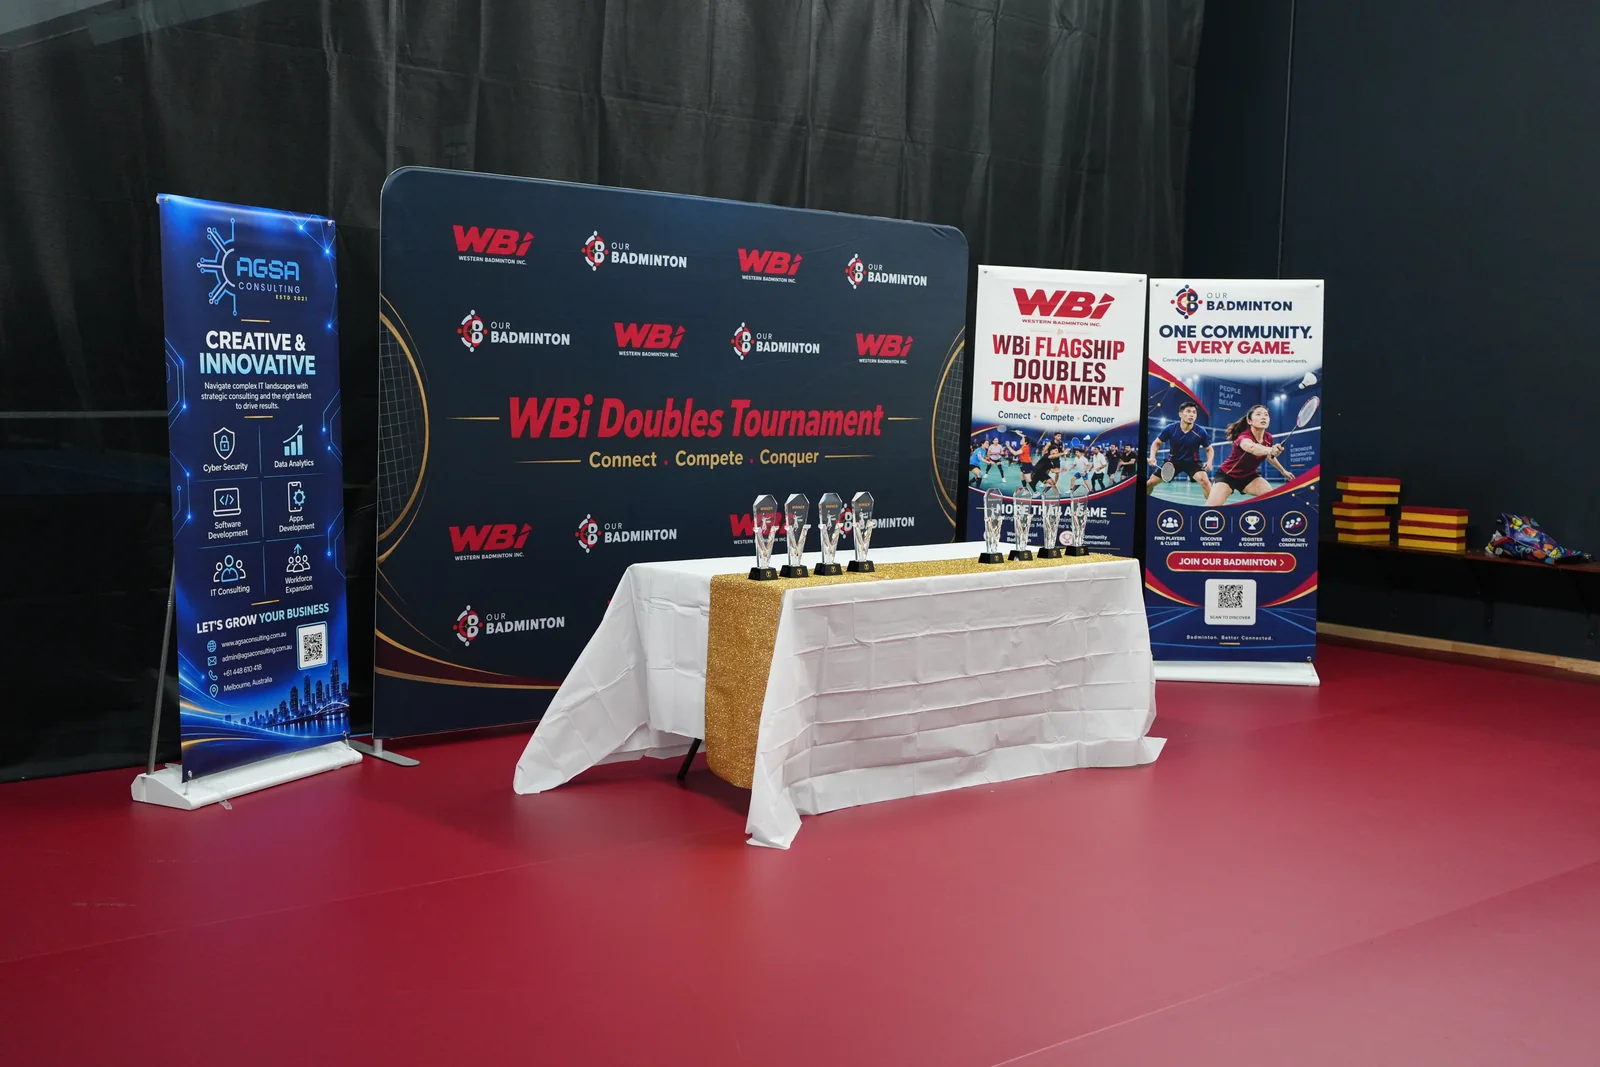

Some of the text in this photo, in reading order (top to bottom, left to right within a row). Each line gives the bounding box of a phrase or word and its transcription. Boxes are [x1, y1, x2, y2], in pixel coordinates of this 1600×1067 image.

[611, 242, 629, 250] OUR
[459, 255, 483, 263] WESTERN
[611, 252, 687, 268] BADMINTON
[237, 257, 299, 281] AGSA
[868, 272, 927, 286] BADMINTON
[238, 282, 300, 293] CONSULTING
[1206, 301, 1292, 311] BADMINTON
[1159, 325, 1313, 339] ONE COMMUNITY.
[206, 331, 306, 351] CREATIVE &
[491, 331, 570, 345] BADMINTON
[756, 341, 820, 354] BADMINTON
[993, 334, 1125, 360] WBi FLAGSHIP
[1177, 341, 1295, 355] EVERY GAME.
[200, 353, 316, 375] INNOVATIVE
[1013, 359, 1106, 383] DOUBLES
[205, 382, 231, 391] Navigate
[233, 383, 257, 391] complex
[265, 382, 295, 390] landscapes
[1220, 385, 1241, 395] PEOPLE
[201, 392, 227, 401] strategic
[229, 393, 258, 401] consulting
[991, 381, 1124, 407] TOURNAMENT
[1219, 399, 1241, 408] BELONG
[509, 394, 884, 438] WBi Doubles Tournament
[998, 411, 1114, 424] Connect Compete Conquer
[290, 460, 314, 468] Analytics
[589, 449, 819, 469] Connect Compete Conquer
[203, 462, 248, 472] Cyber Security
[1064, 506, 1072, 516] A
[289, 515, 303, 523] Apps
[215, 521, 241, 529] Software
[279, 523, 315, 532] Development
[604, 522, 622, 530] OUR
[208, 529, 248, 540] Development
[604, 528, 677, 543] BADMINTON
[1202, 558, 1221, 566] OUR
[1223, 558, 1276, 566] BADMINTON
[285, 575, 312, 584] Workforce
[218, 585, 250, 596] Consulting
[286, 584, 313, 594] Expansion
[197, 603, 329, 634] LET'S GROW YOUR BUSINESS
[486, 613, 506, 621] OUR
[486, 616, 565, 634] BADMINTON
[222, 632, 286, 647] www.agsaconsulting.com.au
[222, 645, 292, 662] admin@agsaconsulting.com.au
[244, 665, 252, 673] 610
[224, 677, 272, 692] Melbourne, Australia
